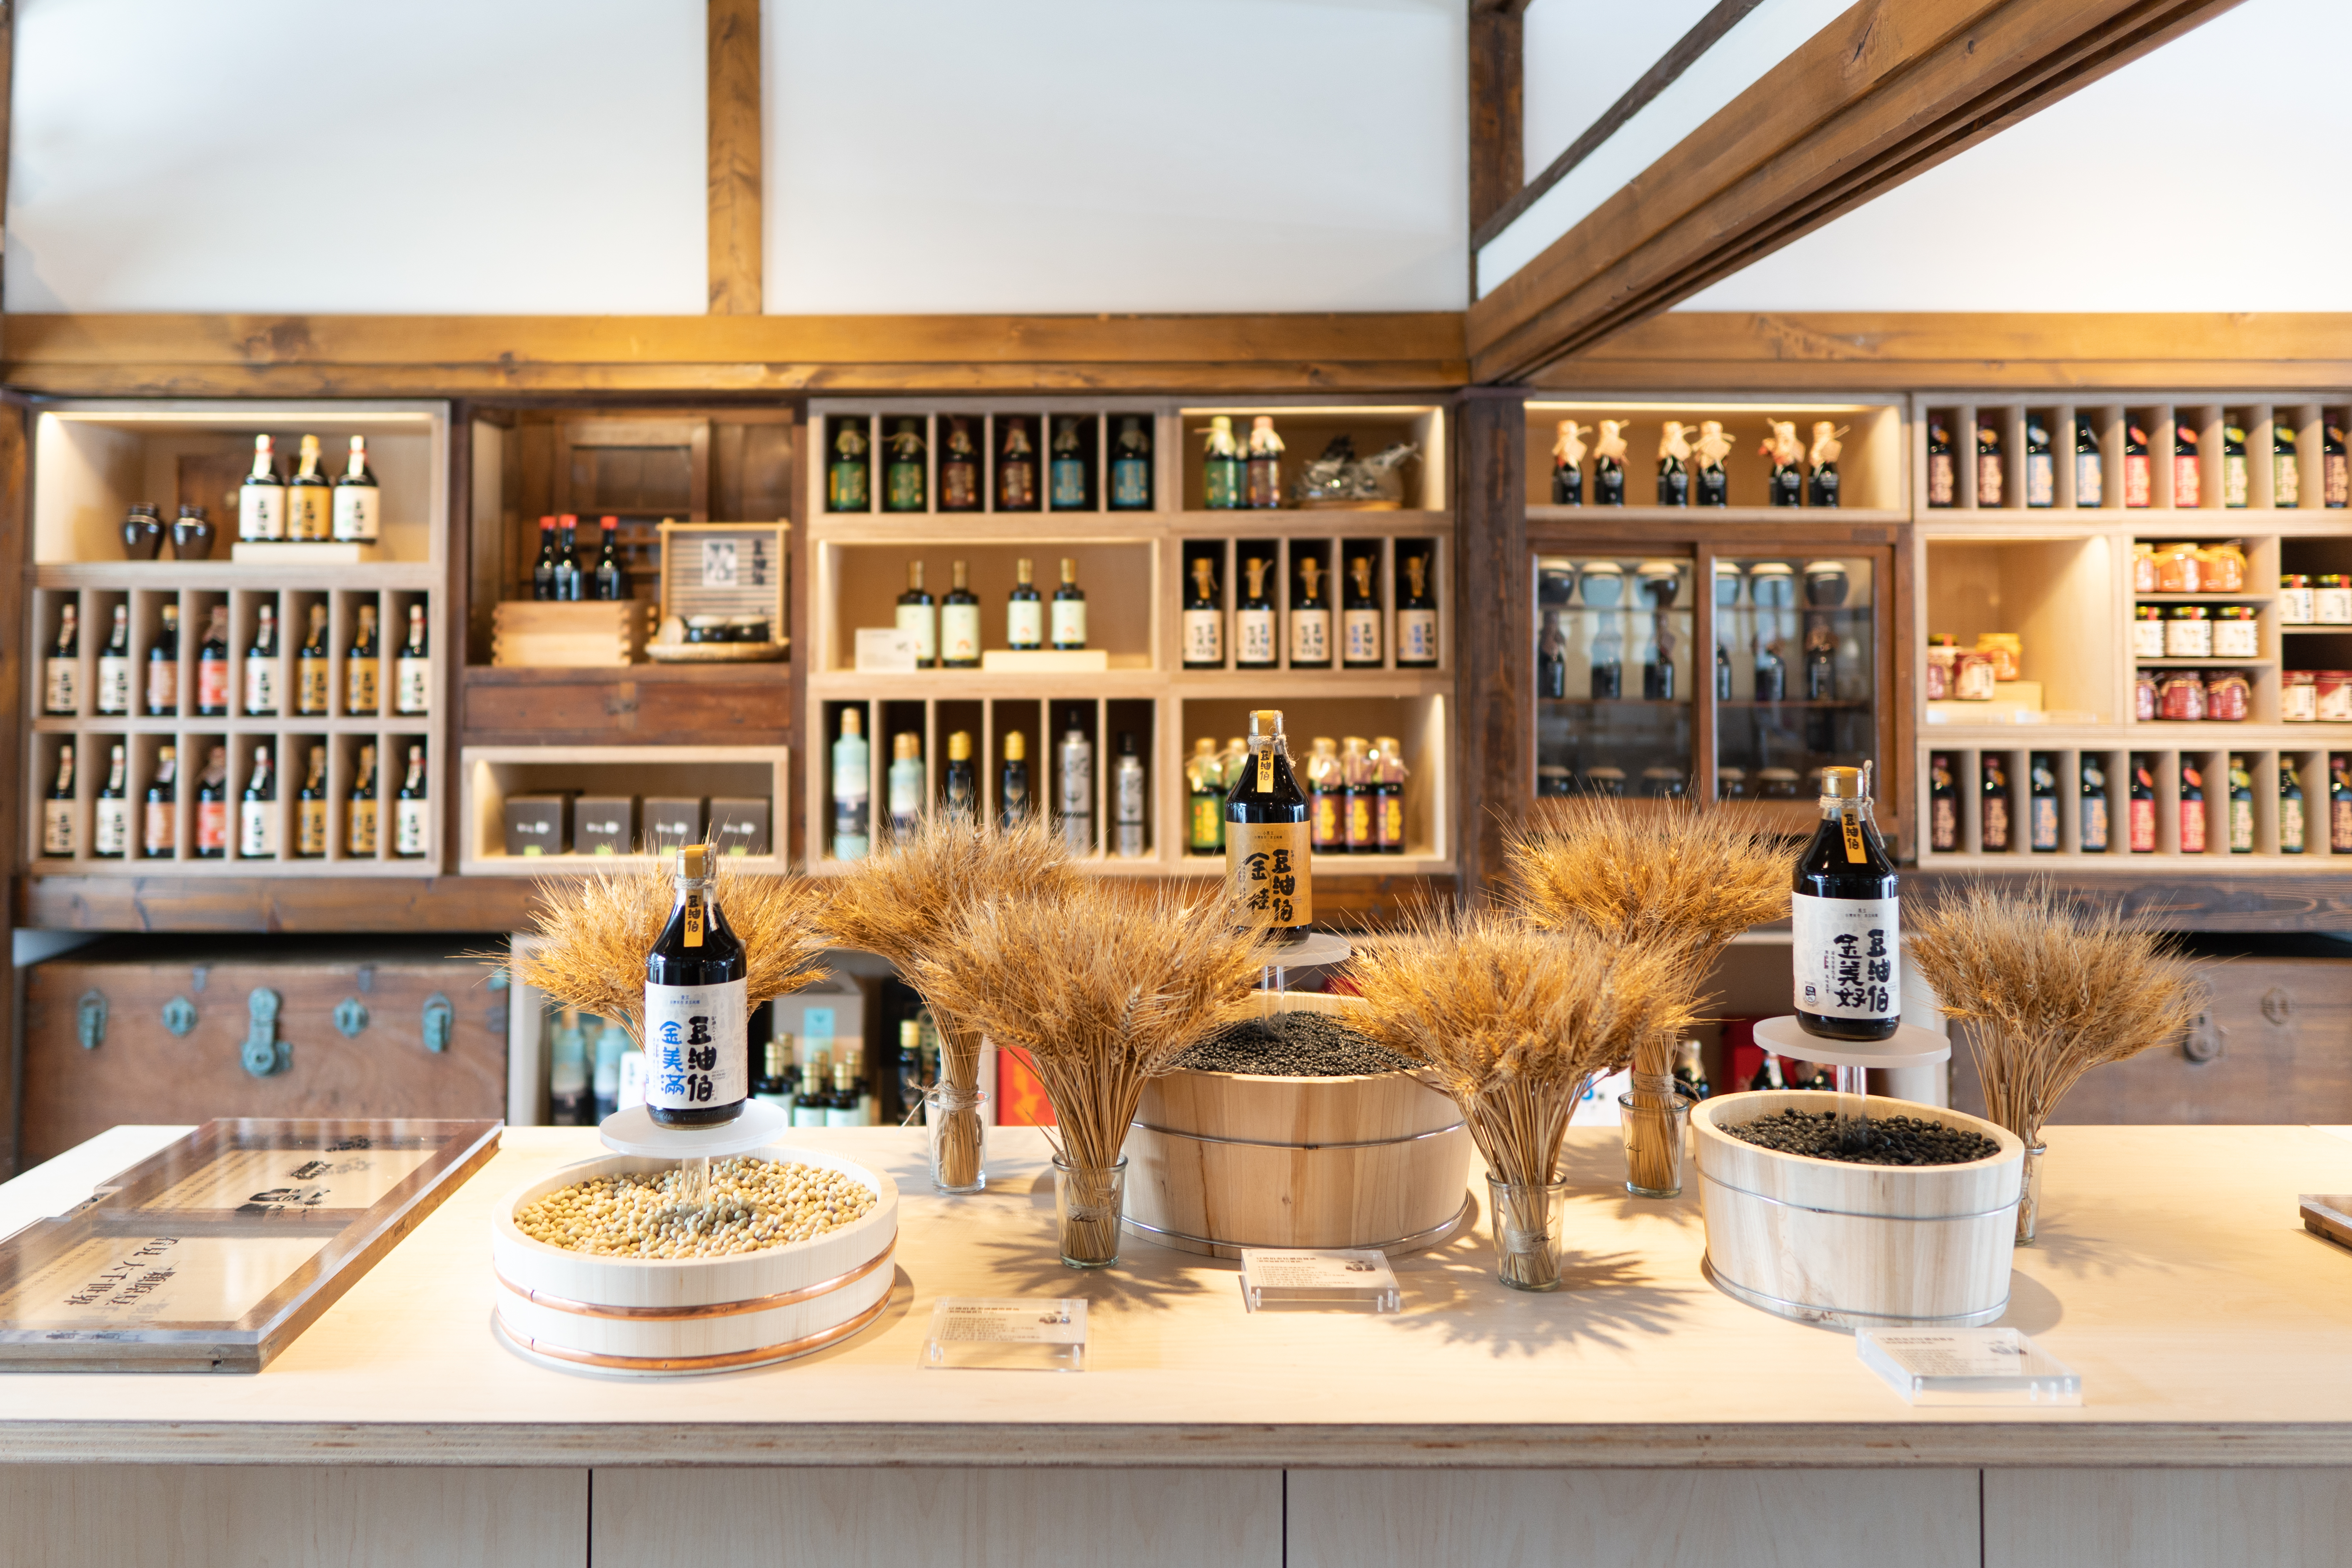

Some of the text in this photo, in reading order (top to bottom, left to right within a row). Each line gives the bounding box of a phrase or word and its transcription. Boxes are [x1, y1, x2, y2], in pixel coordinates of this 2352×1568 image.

[1260, 750, 1271, 781] 豆油伯
[1844, 814, 1859, 850] 豆油伯
[687, 895, 701, 932] 豆油伯
[1243, 852, 1270, 914] 金桂
[1271, 849, 1295, 922] 豆油伯
[1833, 934, 1868, 1008] 金美好
[1866, 929, 1890, 1012] 豆油伯
[659, 1021, 687, 1096] 金美滿
[687, 1016, 717, 1102] 豆油伯
[63, 1237, 181, 1306] 看見 大千世界
[105, 1261, 180, 1306] 一顆原豆
